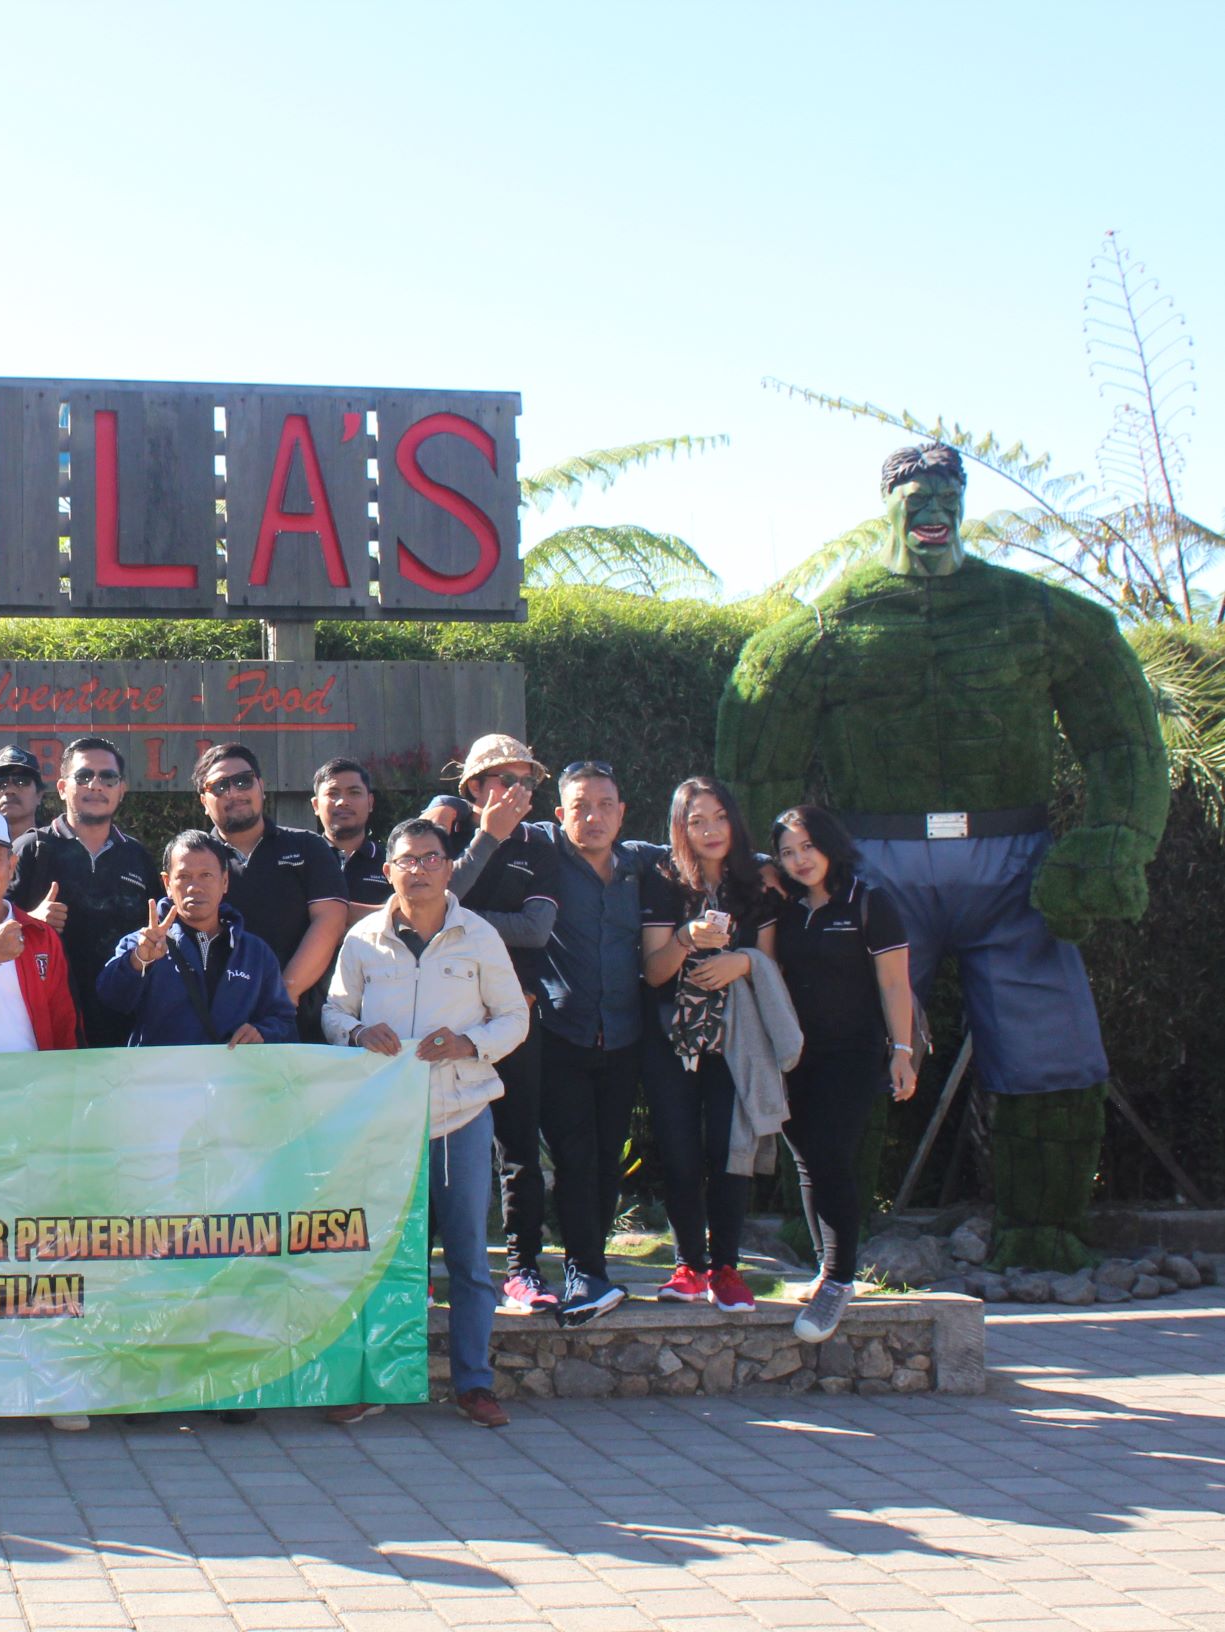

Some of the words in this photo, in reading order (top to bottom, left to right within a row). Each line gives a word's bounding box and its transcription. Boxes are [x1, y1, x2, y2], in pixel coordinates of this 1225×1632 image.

[226, 669, 337, 722] Food
[15, 1212, 281, 1261] PEMERINTAHAN
[288, 1208, 370, 1255] DESA
